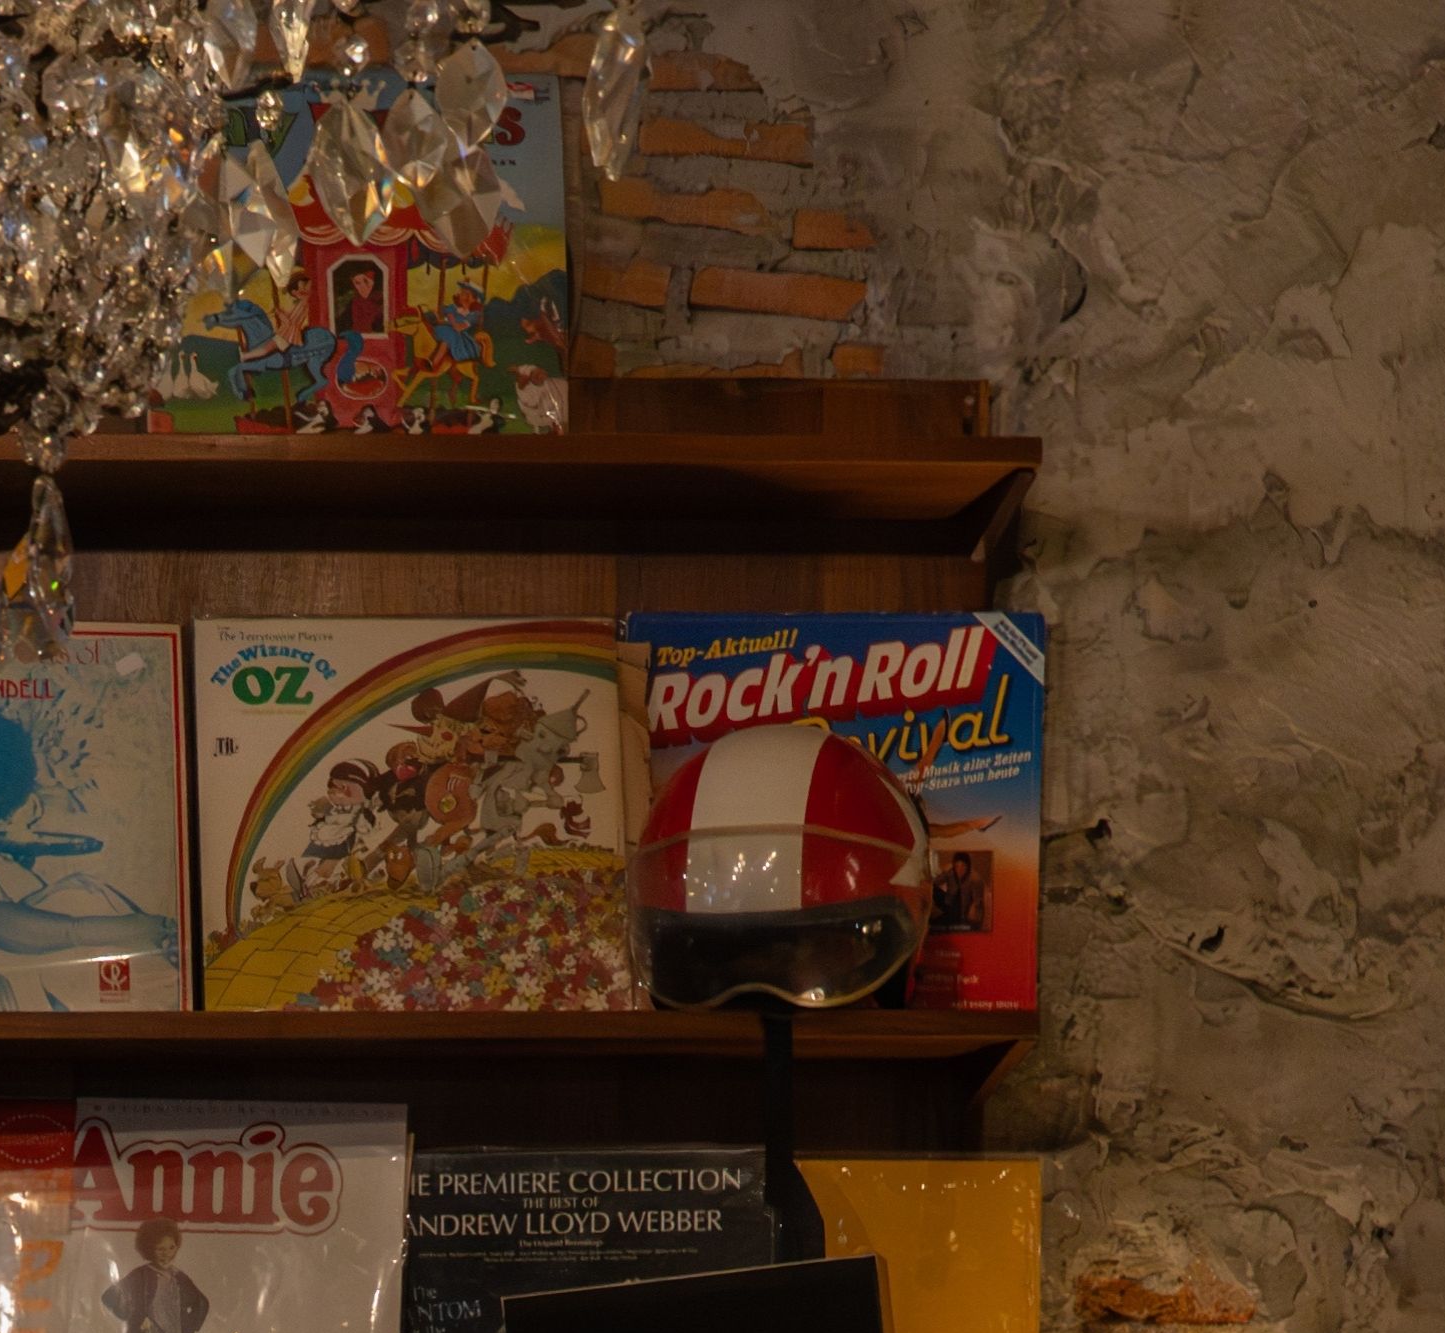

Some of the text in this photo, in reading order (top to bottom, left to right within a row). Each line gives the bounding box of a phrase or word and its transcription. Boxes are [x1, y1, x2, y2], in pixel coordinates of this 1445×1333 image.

[237, 645, 315, 664] Wizard
[656, 628, 799, 667] Top-Aktuell!
[858, 626, 988, 704] Roll
[232, 666, 314, 705] OZ
[791, 673, 1011, 762] vival
[70, 1122, 338, 1230] Annie
[439, 1172, 562, 1196] PREMIERE
[568, 1168, 742, 1194] COLLECTION
[522, 1197, 599, 1210] THE BEST OF
[525, 1211, 611, 1235] LLOYD
[617, 1208, 724, 1234] WEBBER
